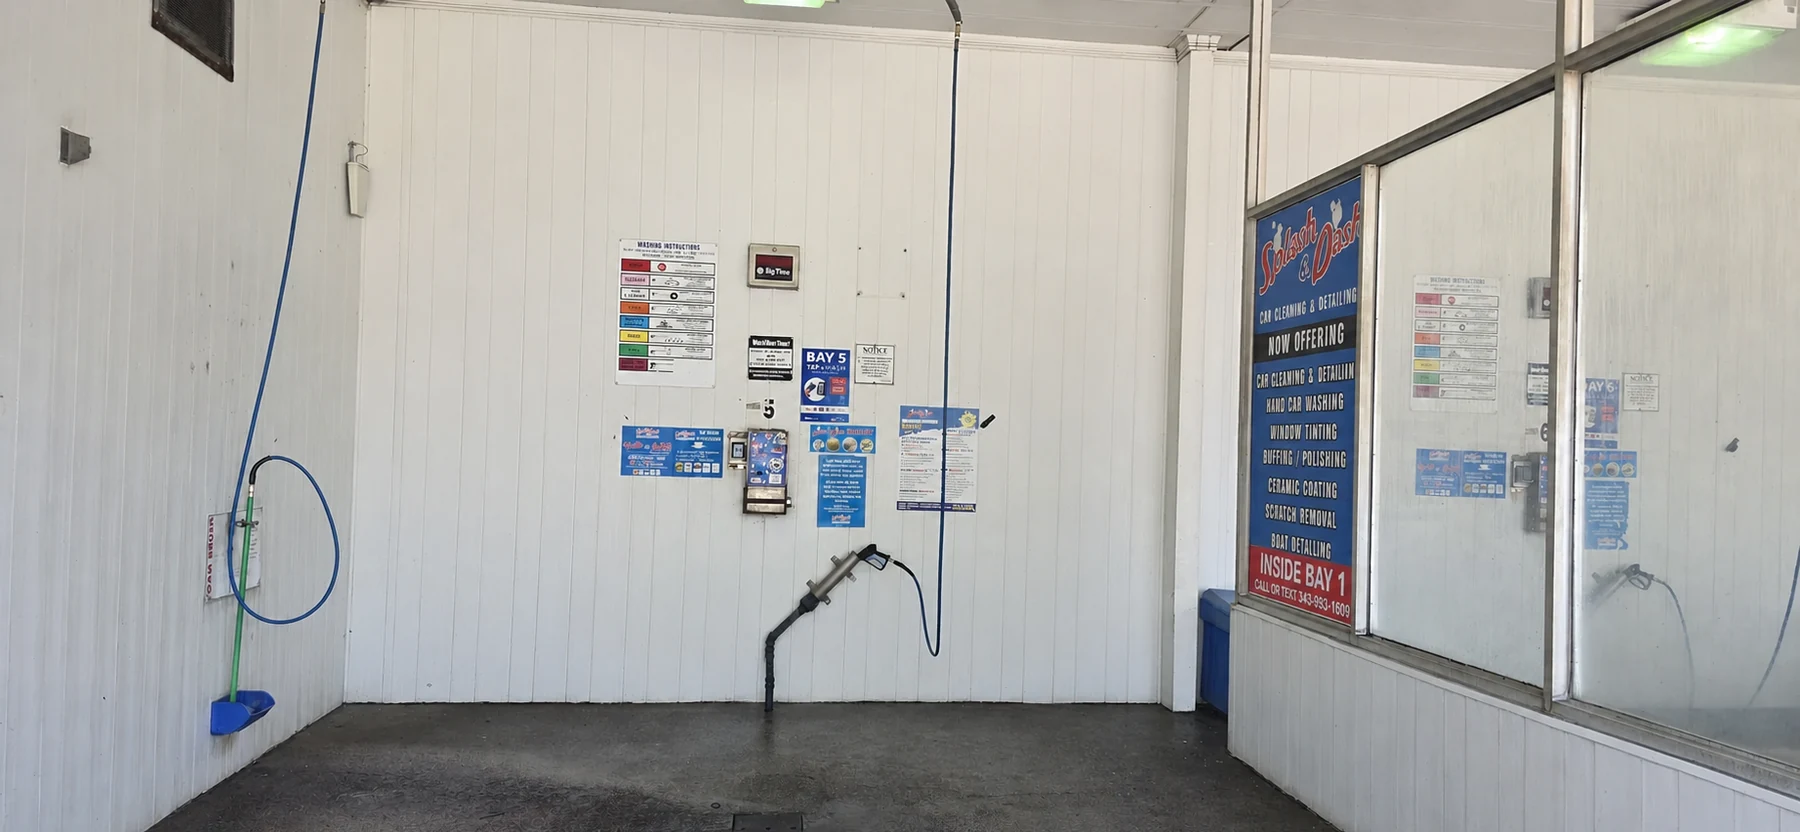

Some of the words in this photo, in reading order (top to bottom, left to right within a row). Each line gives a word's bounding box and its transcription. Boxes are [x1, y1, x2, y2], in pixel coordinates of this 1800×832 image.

[1259, 206, 1318, 296] Splash
[1260, 310, 1271, 324] CAR
[1275, 301, 1306, 321] CLEANING
[1310, 299, 1315, 313] &
[1319, 287, 1357, 310] DETAILING
[1268, 333, 1290, 356] NOW
[1294, 322, 1344, 352] OFFERING
[807, 351, 835, 363] BAY
[838, 353, 847, 363] 5
[1256, 374, 1269, 389] CAR
[1271, 369, 1305, 387] CLEANING
[1308, 368, 1314, 383] &
[1587, 381, 1604, 392] AY
[1266, 397, 1285, 413] HAND
[1288, 396, 1302, 412] CAR
[1305, 393, 1344, 411] WASHING
[1270, 424, 1302, 440] WINDOW
[1305, 423, 1337, 440] TINTING
[1263, 449, 1293, 465] BUFFING
[1302, 451, 1347, 468] POLISHING
[1268, 477, 1300, 495] CERAMIC
[1303, 480, 1337, 499] COATING
[1265, 503, 1296, 522] SCRATCH
[1300, 508, 1337, 529] REMOVAL
[1271, 533, 1288, 551] BOAT
[1260, 552, 1301, 584] INSIDE
[1305, 562, 1333, 592] BAY
[1338, 571, 1345, 597] 1
[1254, 579, 1270, 593] CALL
[1271, 584, 1280, 595] OR
[1281, 586, 1297, 601] TEXT
